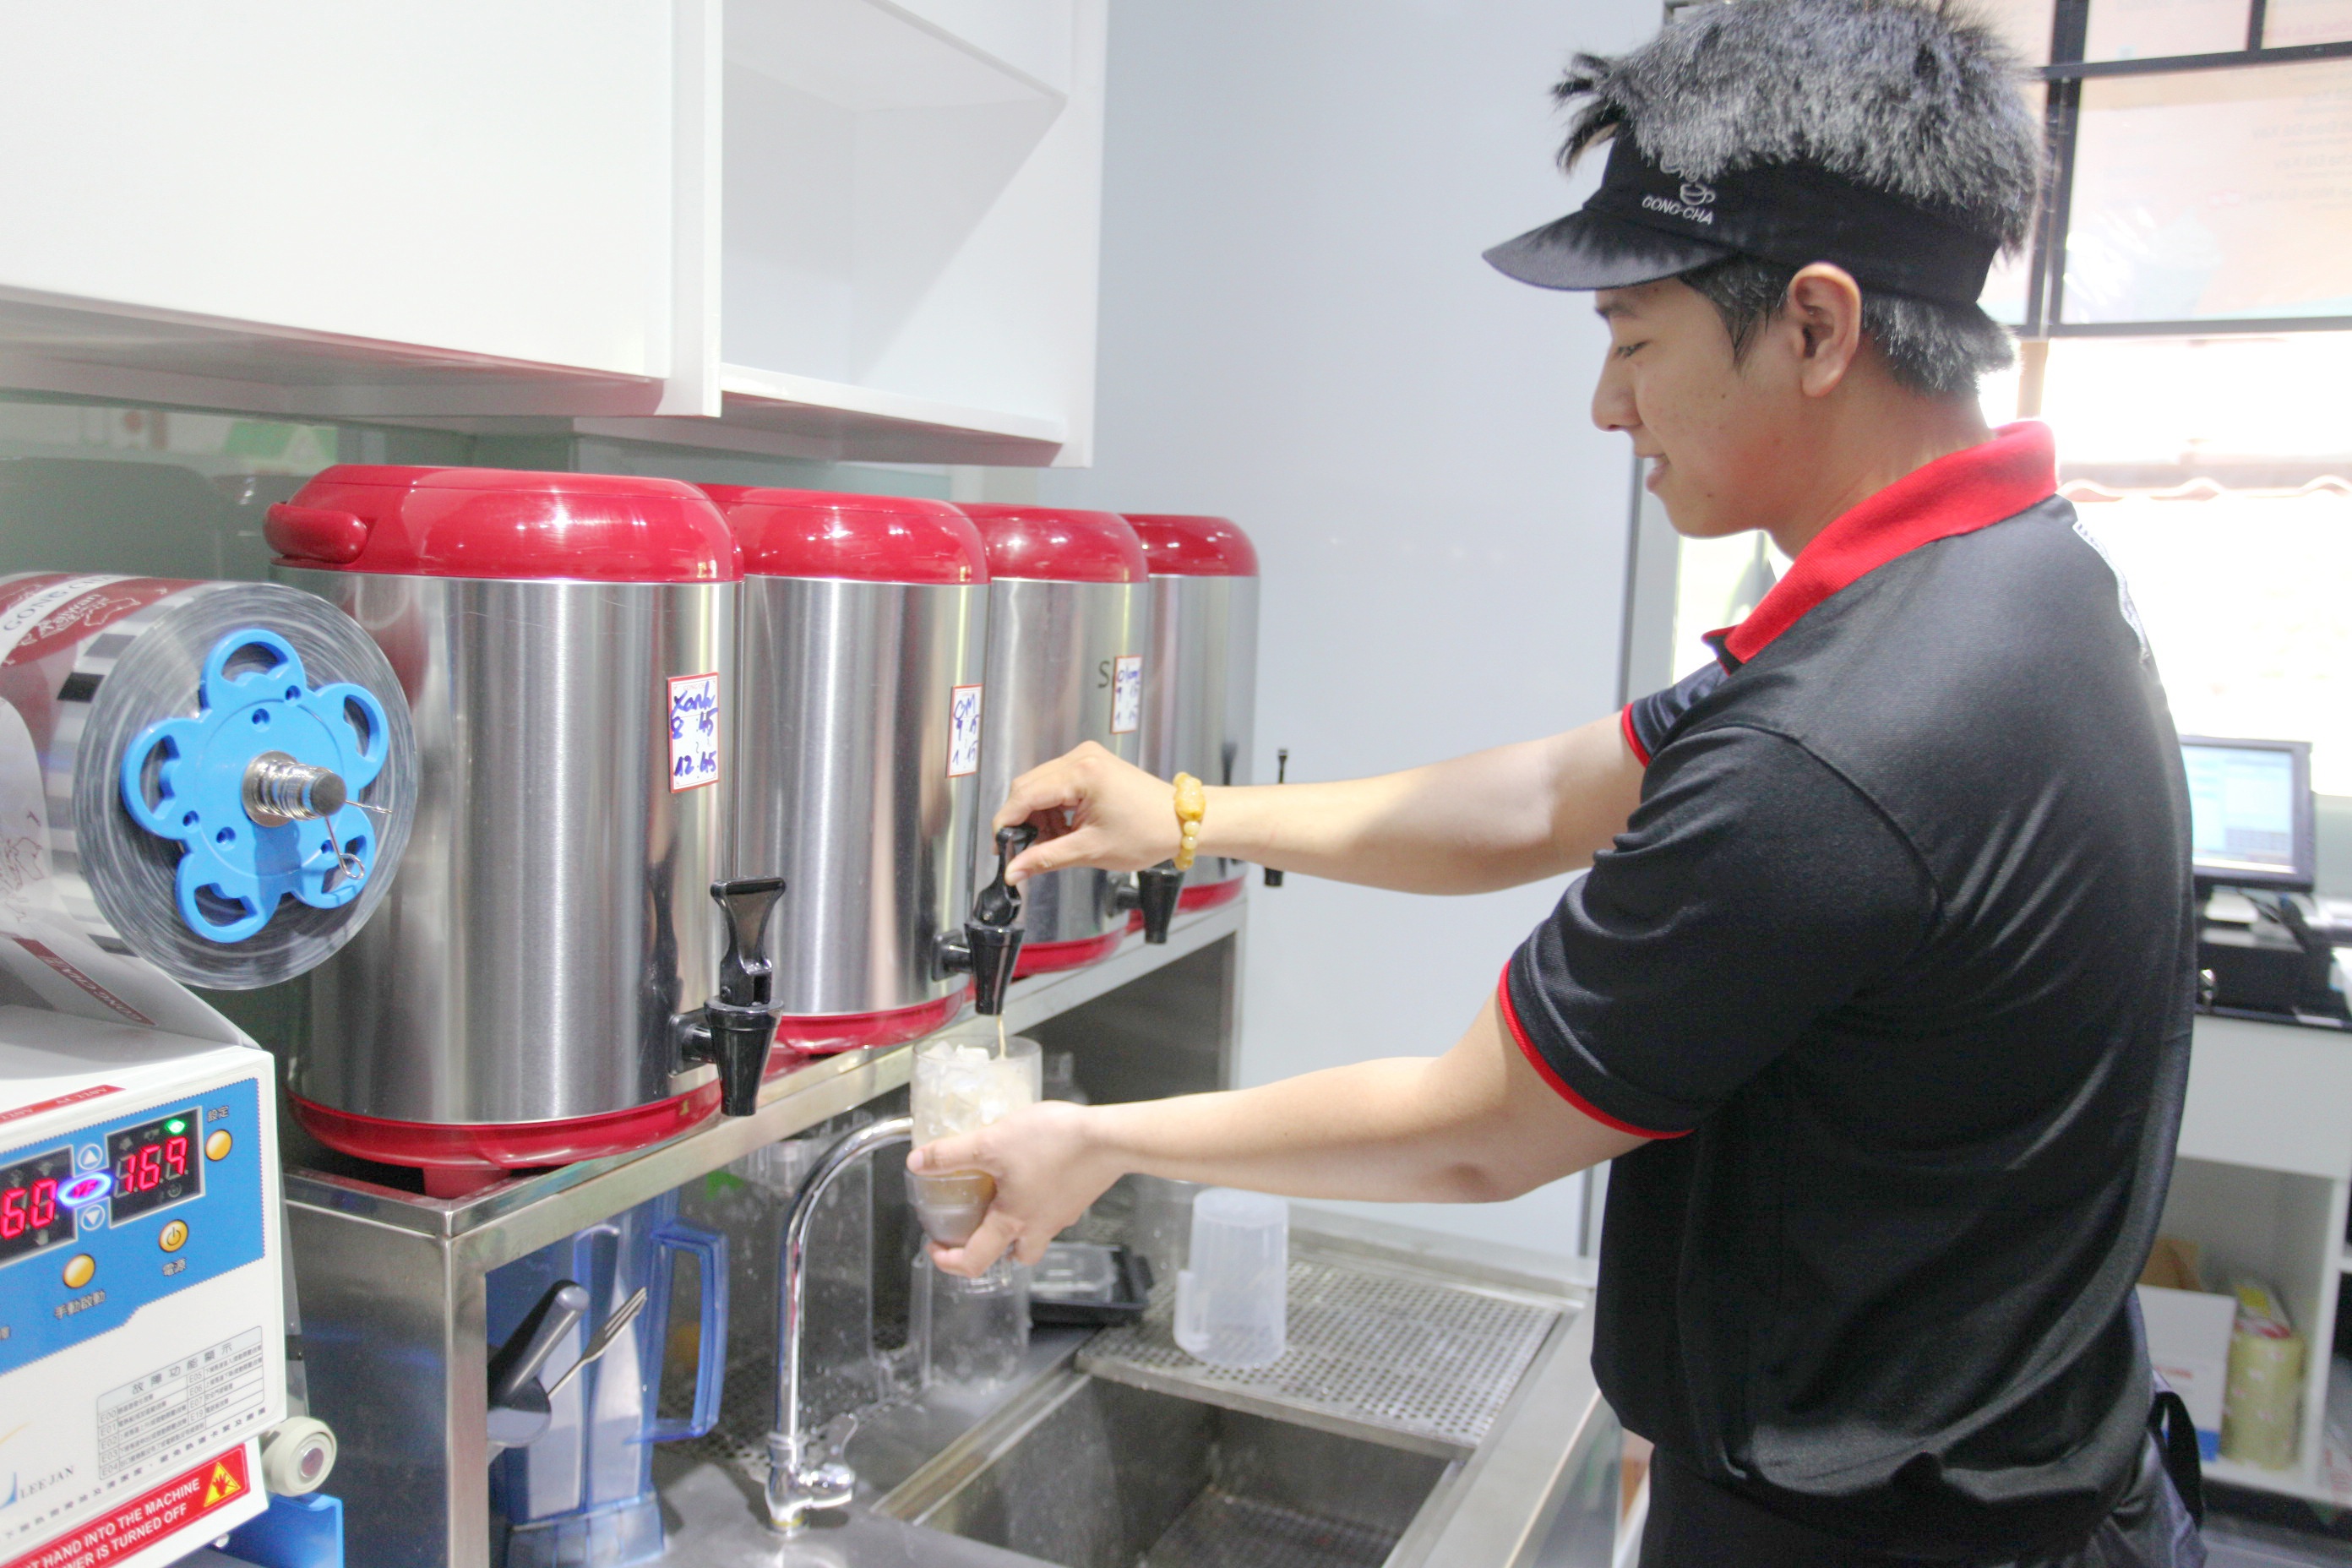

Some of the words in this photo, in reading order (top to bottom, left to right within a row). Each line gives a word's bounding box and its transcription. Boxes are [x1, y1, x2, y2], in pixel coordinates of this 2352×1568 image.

[3, 591, 67, 631] GONG
[123, 1136, 188, 1194] 169
[41, 1540, 82, 1568] HAND
[84, 1522, 116, 1549] INTO
[117, 1507, 143, 1530] THE
[144, 1478, 201, 1516] MACHINE
[96, 1544, 110, 1560] IS
[111, 1516, 162, 1552] TURNED
[164, 1502, 187, 1524] OFF
